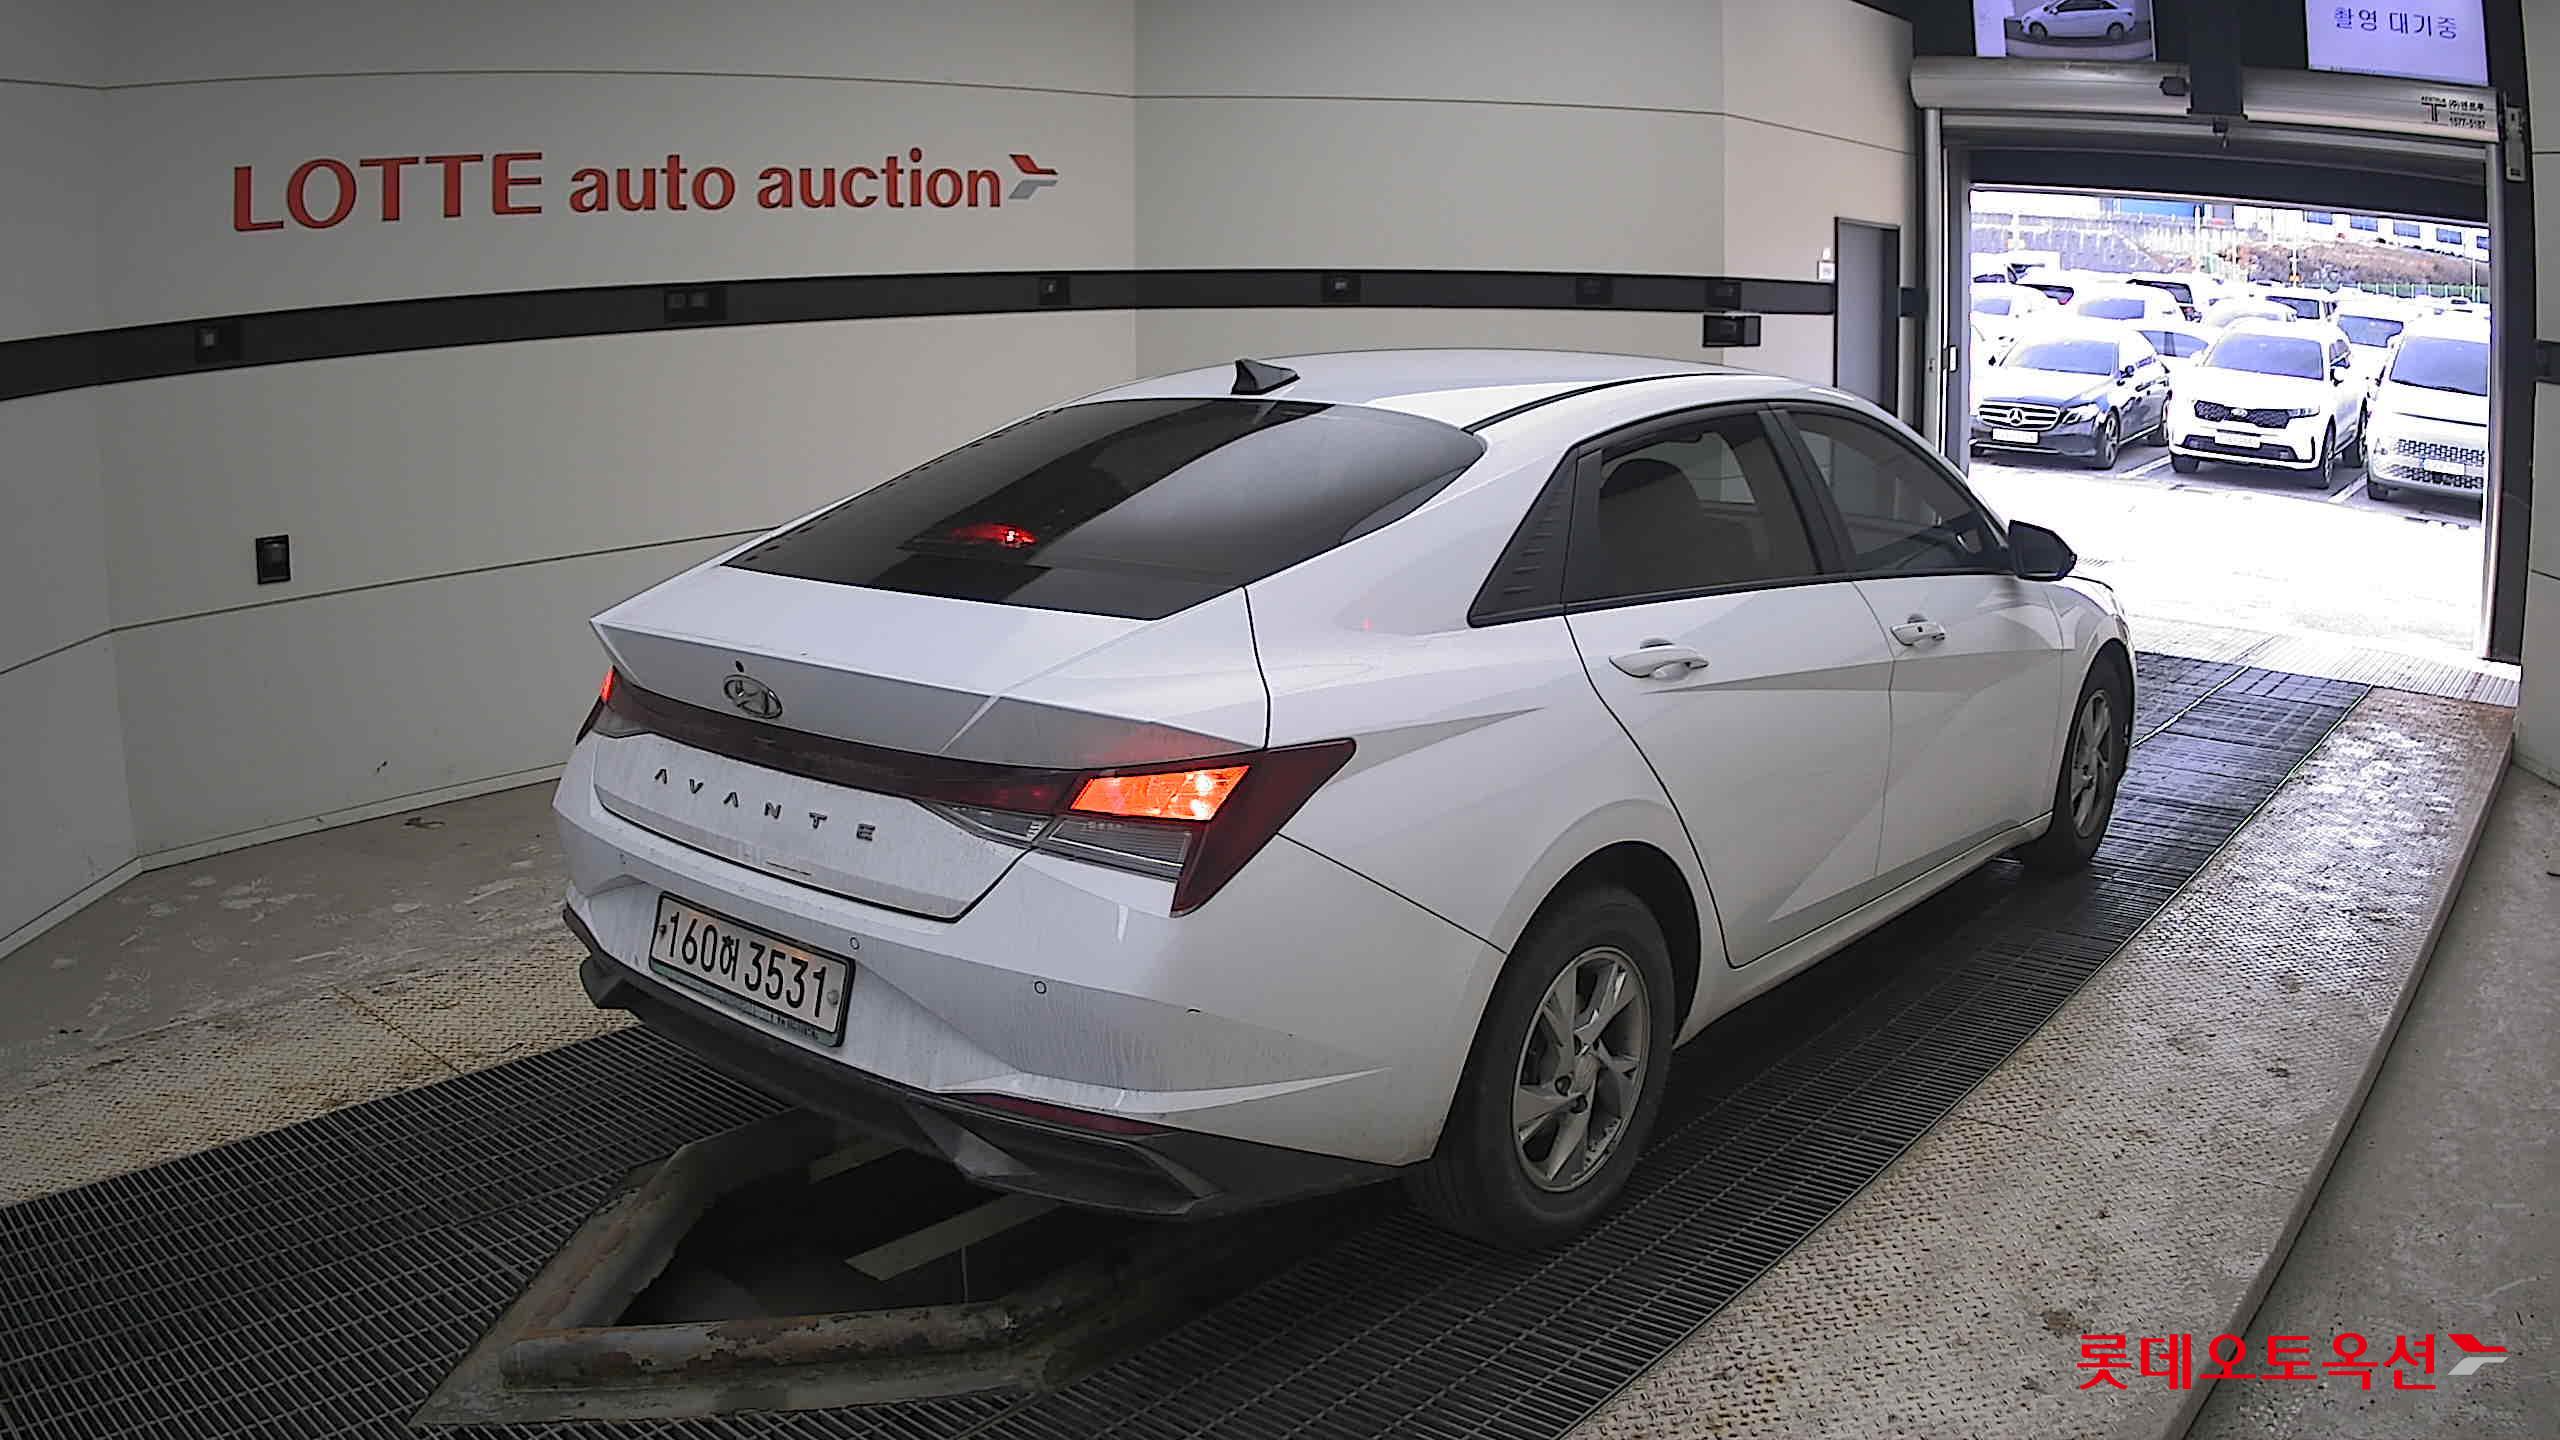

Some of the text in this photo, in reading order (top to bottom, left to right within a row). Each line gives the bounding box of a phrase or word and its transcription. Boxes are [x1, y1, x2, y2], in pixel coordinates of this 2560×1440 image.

[2334, 7, 2458, 40] 촬영 대기중
[234, 147, 1004, 232] LOTTE auto auction
[653, 767, 877, 843] AVANTE
